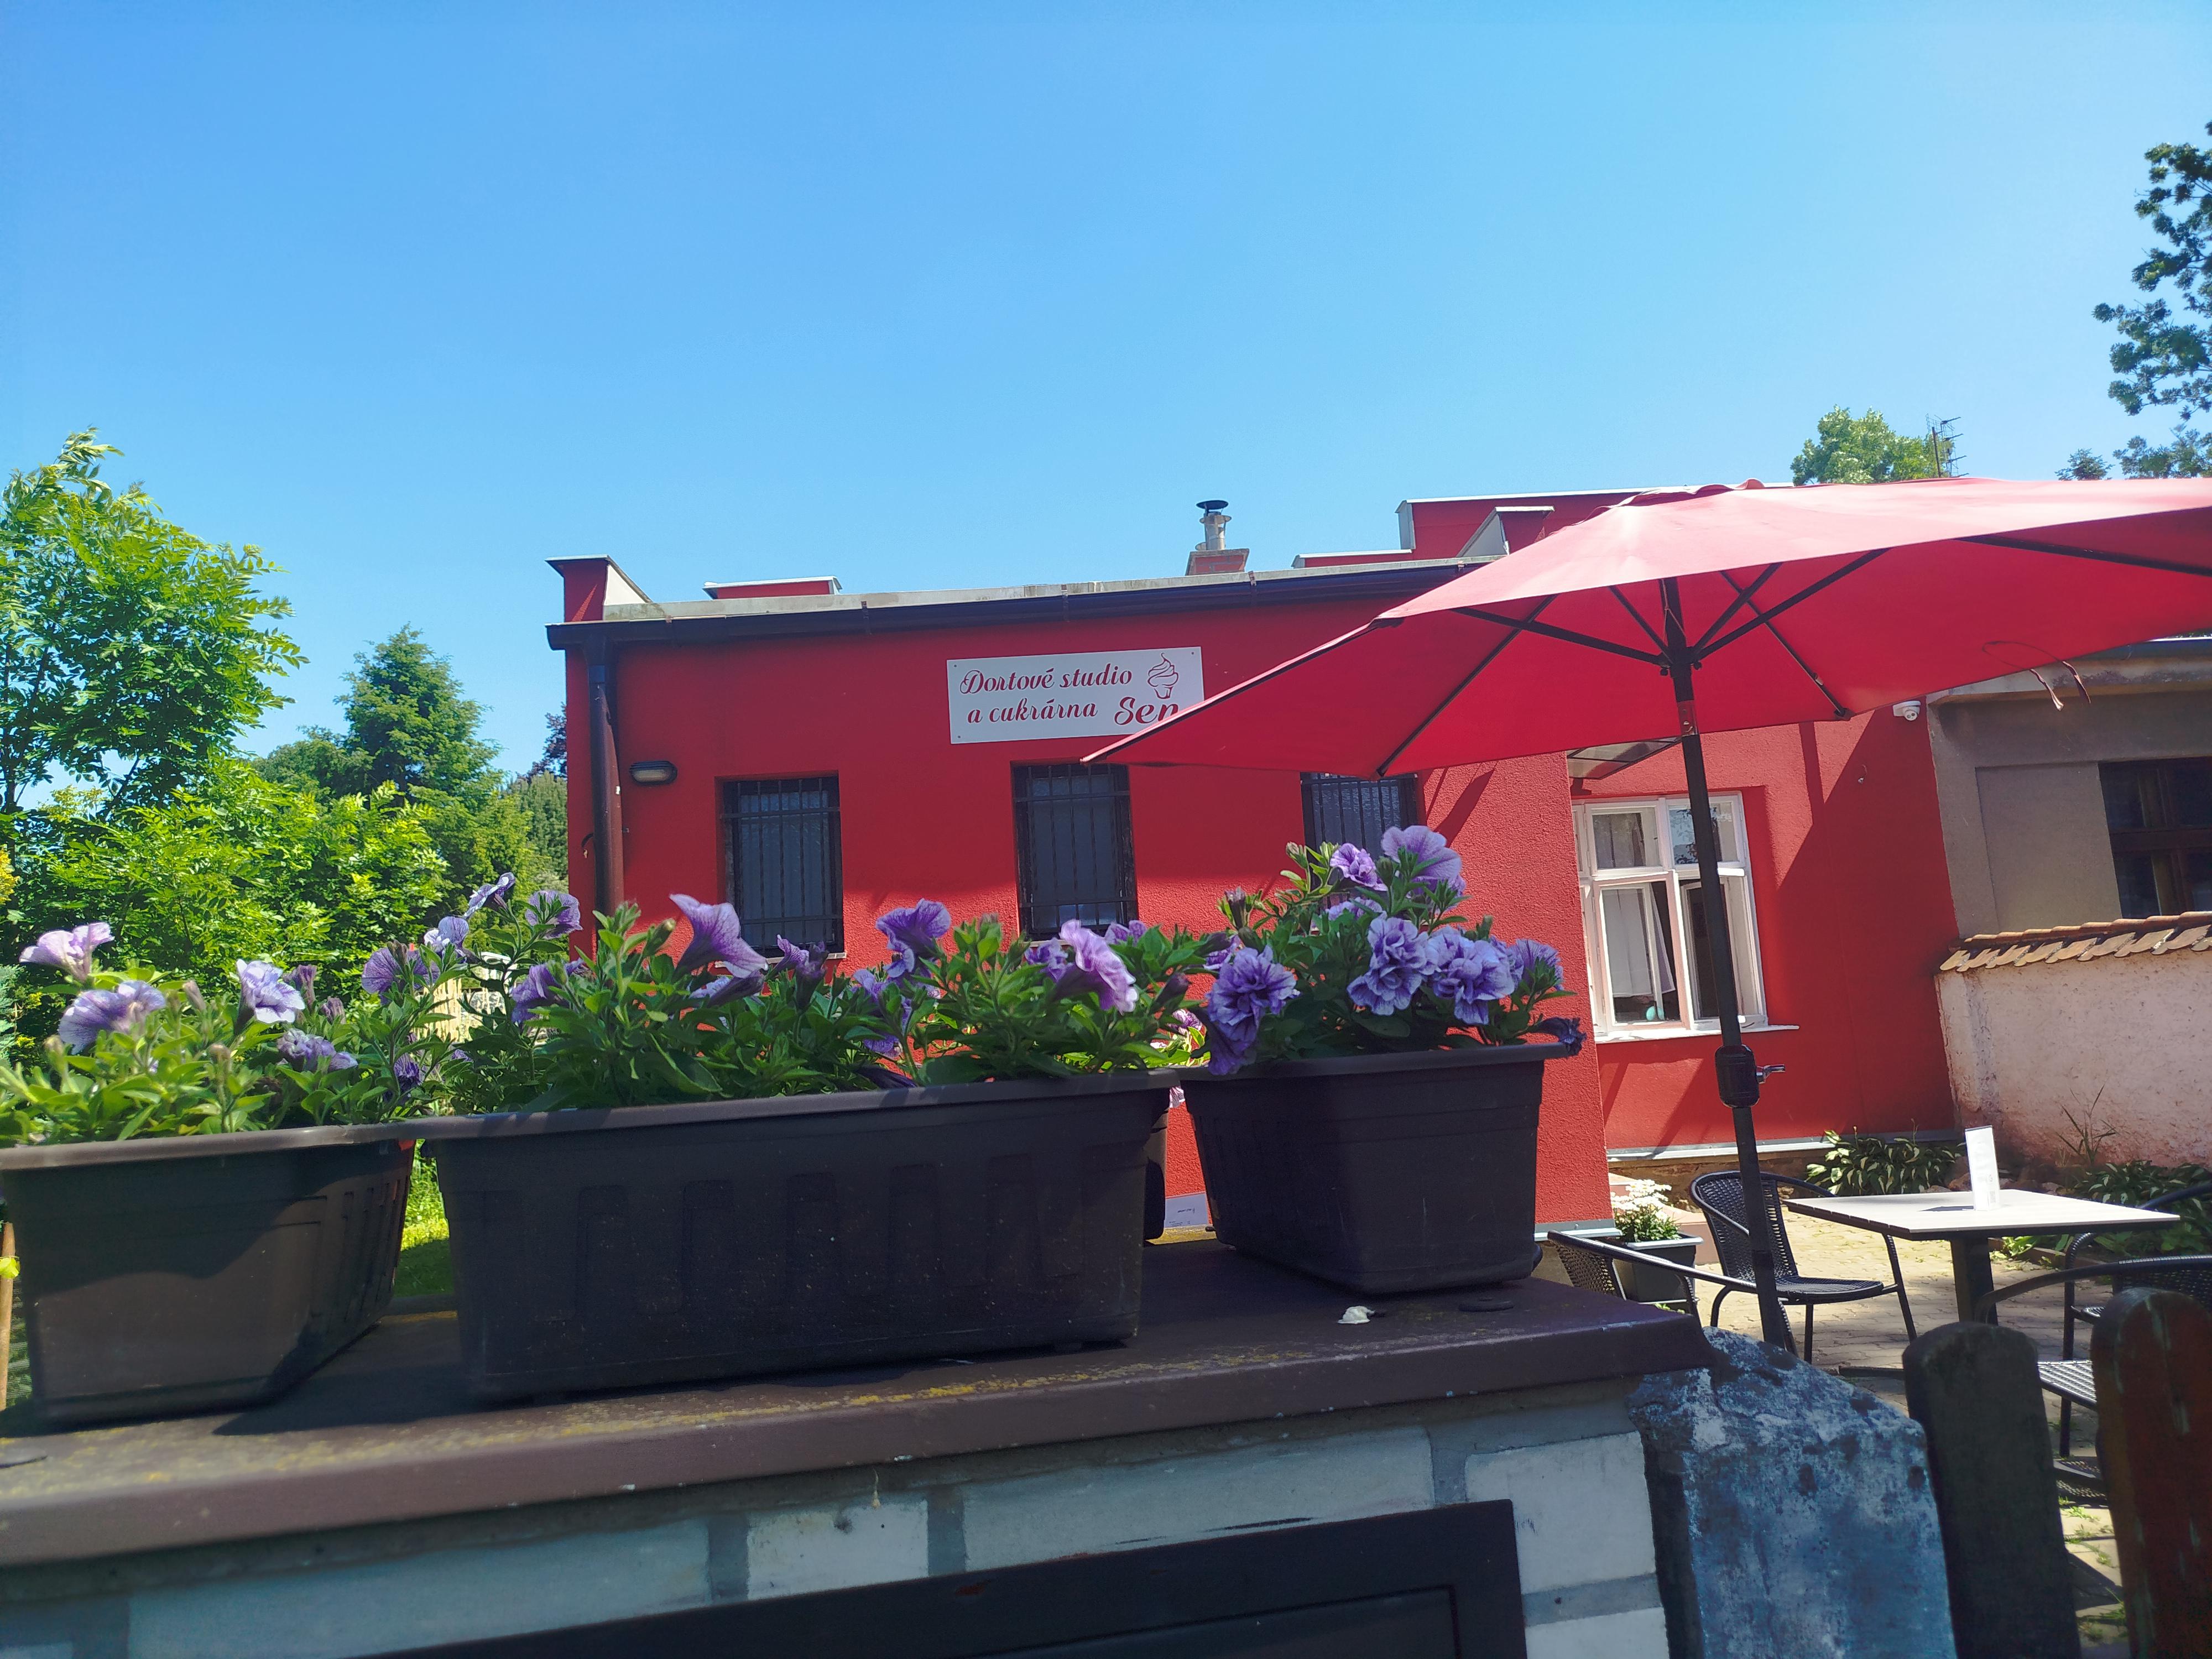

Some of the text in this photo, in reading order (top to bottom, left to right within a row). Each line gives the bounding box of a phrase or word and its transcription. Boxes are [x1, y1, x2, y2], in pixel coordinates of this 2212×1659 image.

[959, 663, 1132, 695] Dortové studio
[967, 696, 1178, 725] a cukrárna Sen
